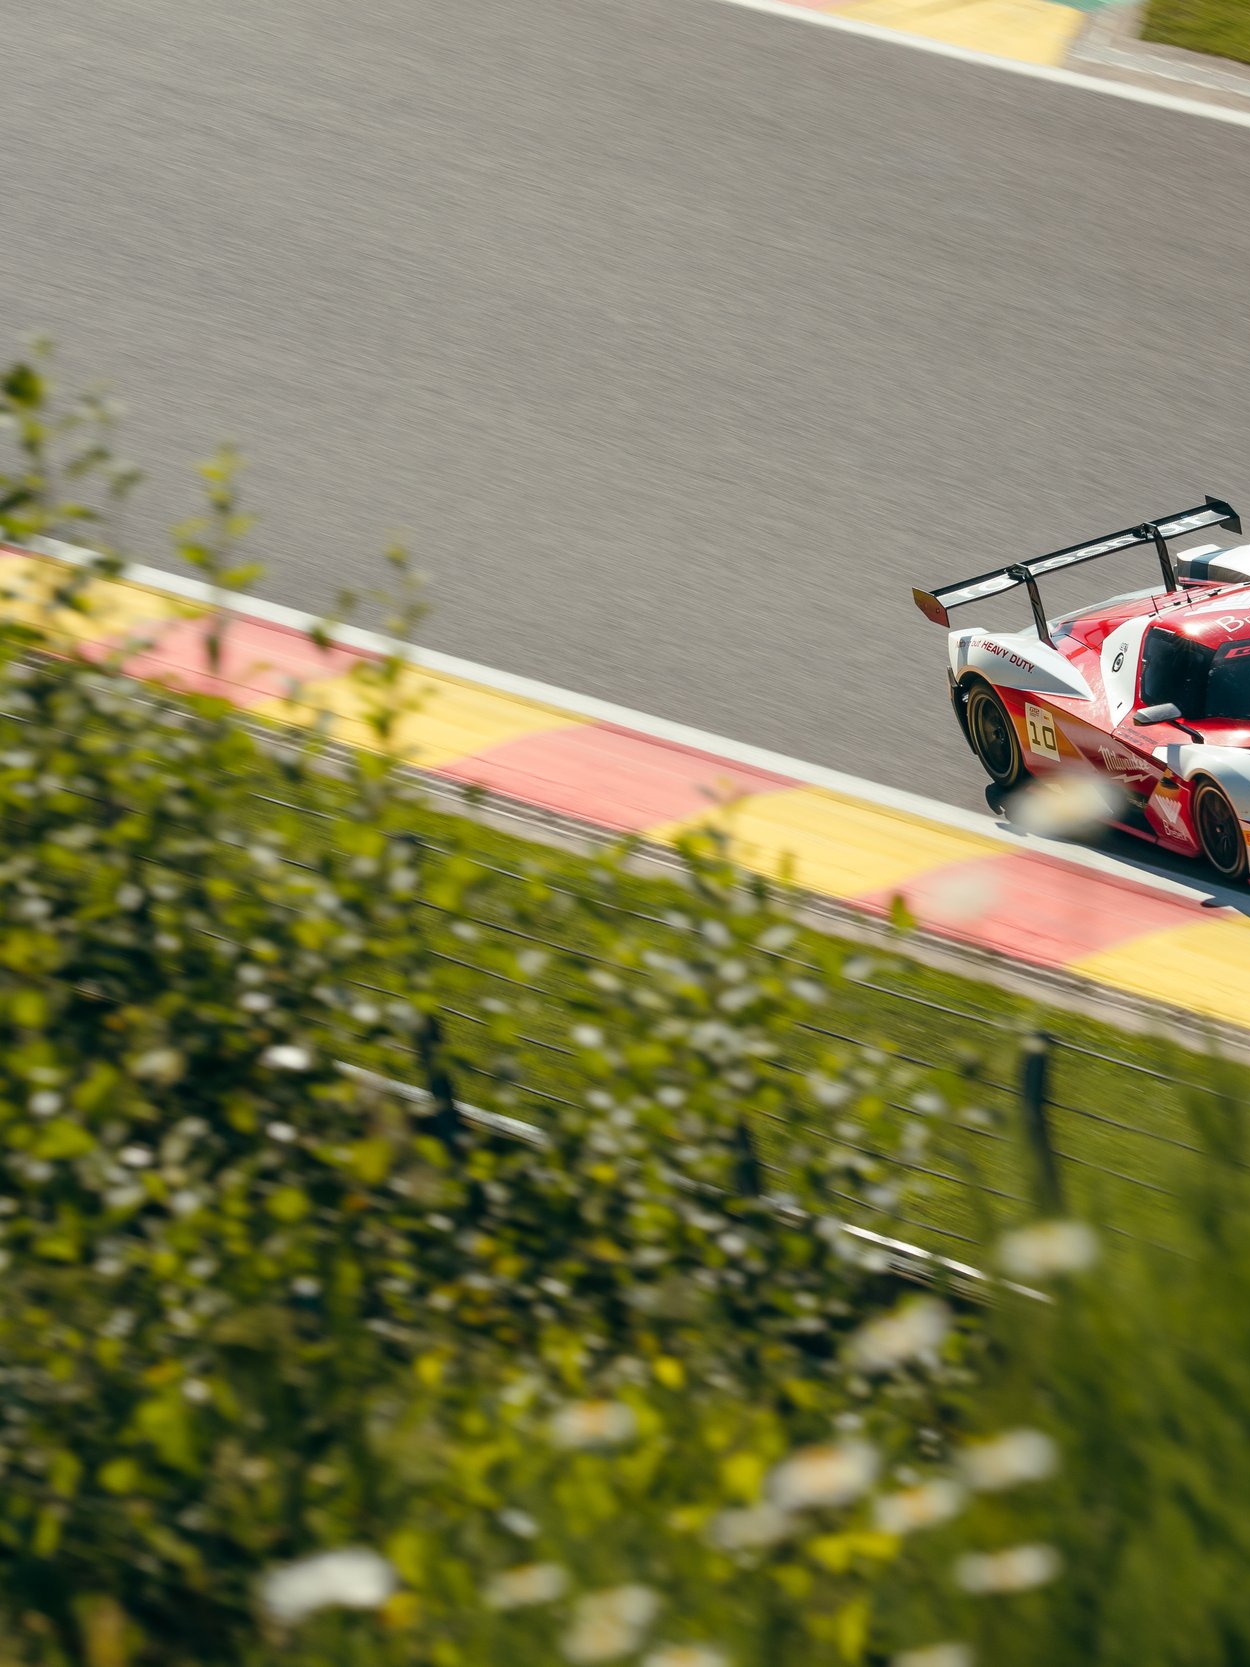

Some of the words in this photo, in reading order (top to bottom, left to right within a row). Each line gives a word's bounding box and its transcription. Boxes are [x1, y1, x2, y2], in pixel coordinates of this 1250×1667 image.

[981, 640, 1009, 659] HEAVY
[1009, 654, 1035, 674] DUTY.
[1029, 720, 1057, 751] 10
